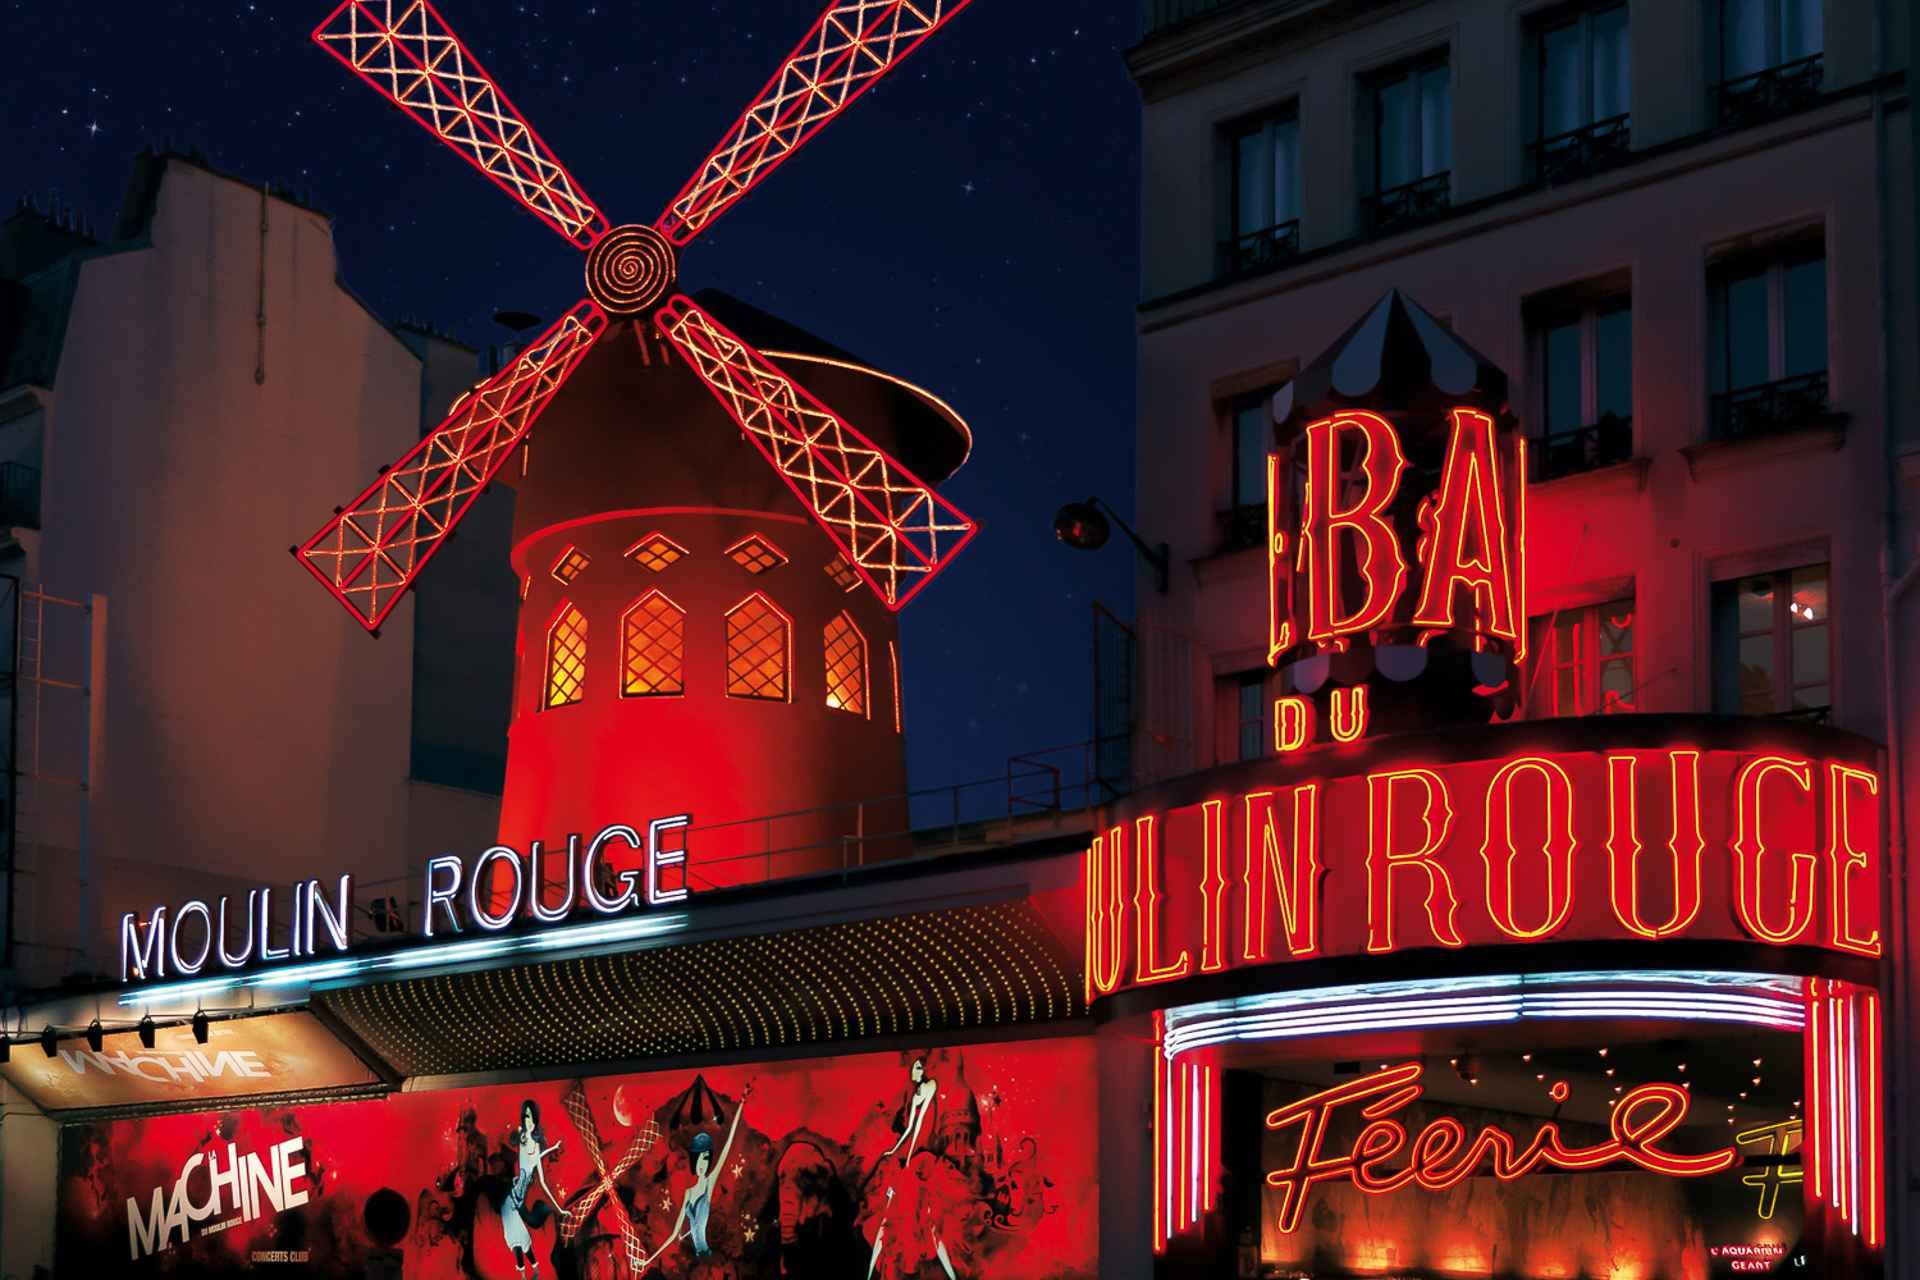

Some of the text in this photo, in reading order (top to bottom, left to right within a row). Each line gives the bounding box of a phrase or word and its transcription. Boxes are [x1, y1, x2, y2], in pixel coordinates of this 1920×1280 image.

[1273, 685, 1367, 753] DU
[120, 813, 690, 984] MOULIN ROUGE
[1084, 748, 1882, 1004] ULIN ROUGE
[126, 1135, 310, 1262] MACHINE
[1266, 1060, 1737, 1234] Féerie
[251, 1250, 310, 1263] CONCERTS CLUB
